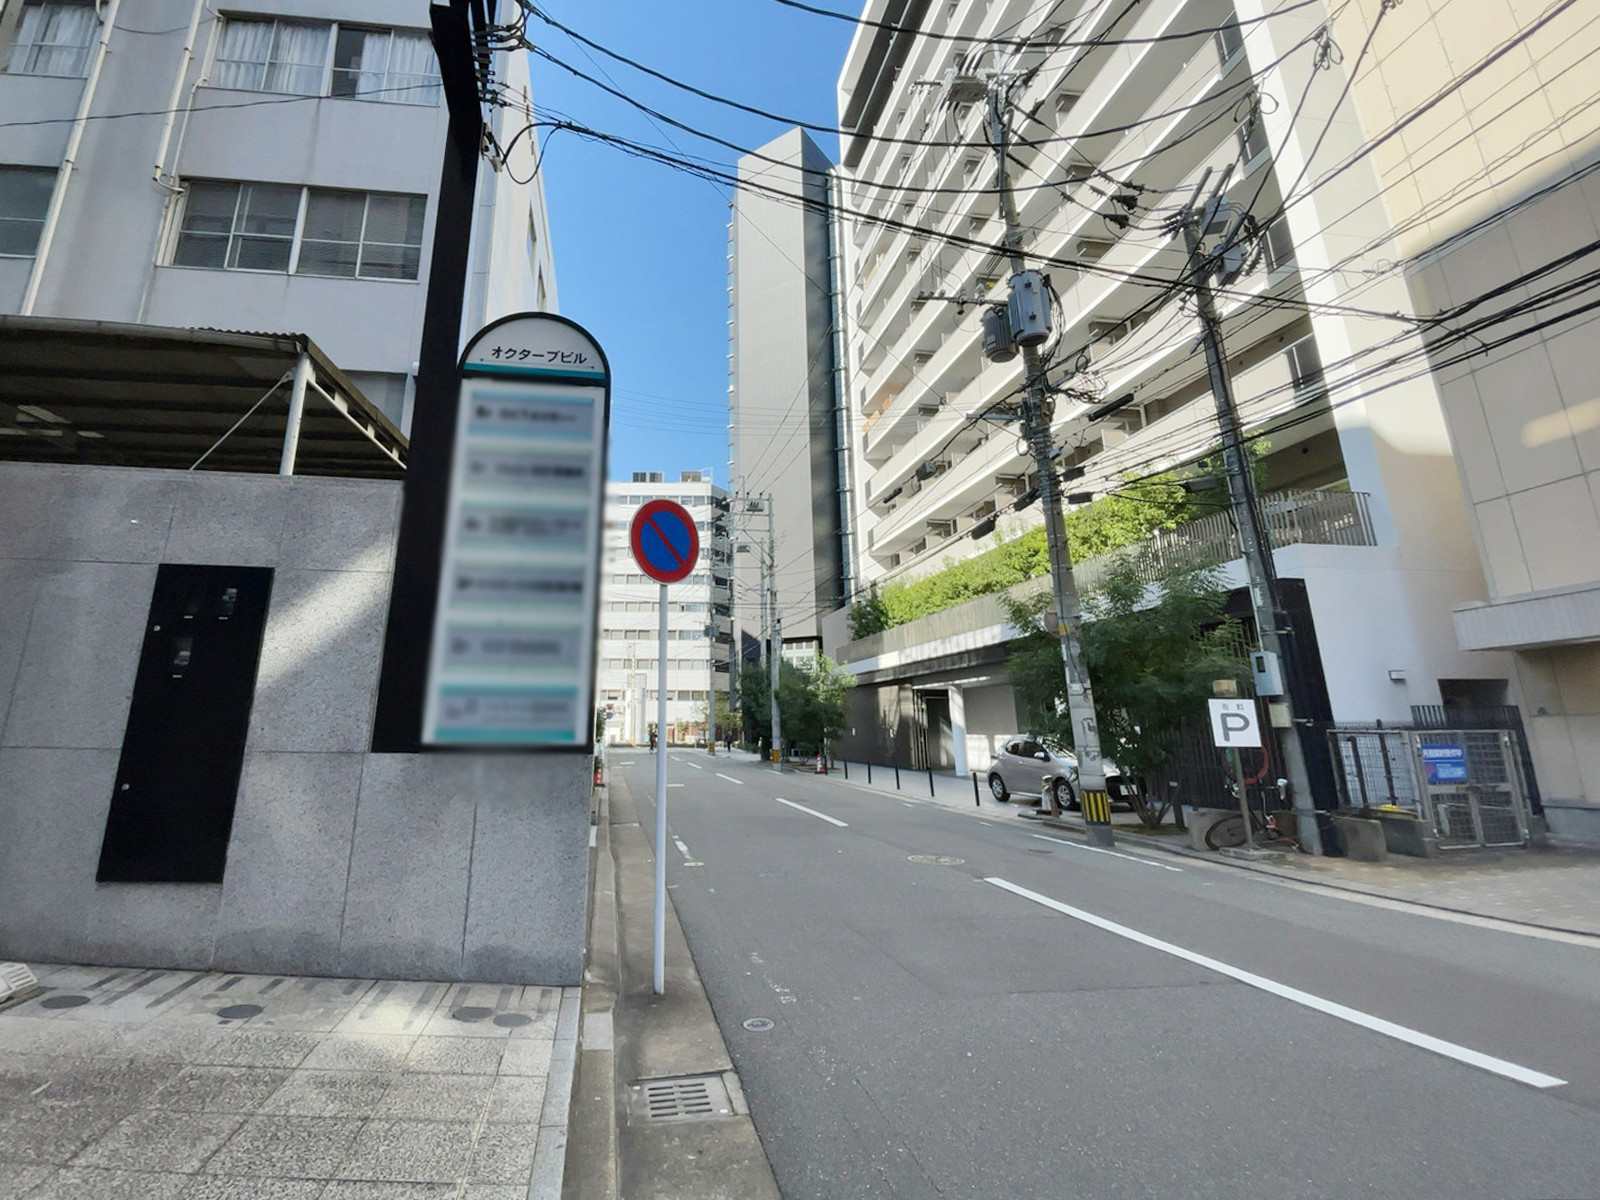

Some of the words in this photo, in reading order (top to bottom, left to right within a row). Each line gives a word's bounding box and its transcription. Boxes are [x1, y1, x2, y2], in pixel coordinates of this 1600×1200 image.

[491, 346, 587, 365] オクターブビル
[1220, 712, 1250, 741] P
